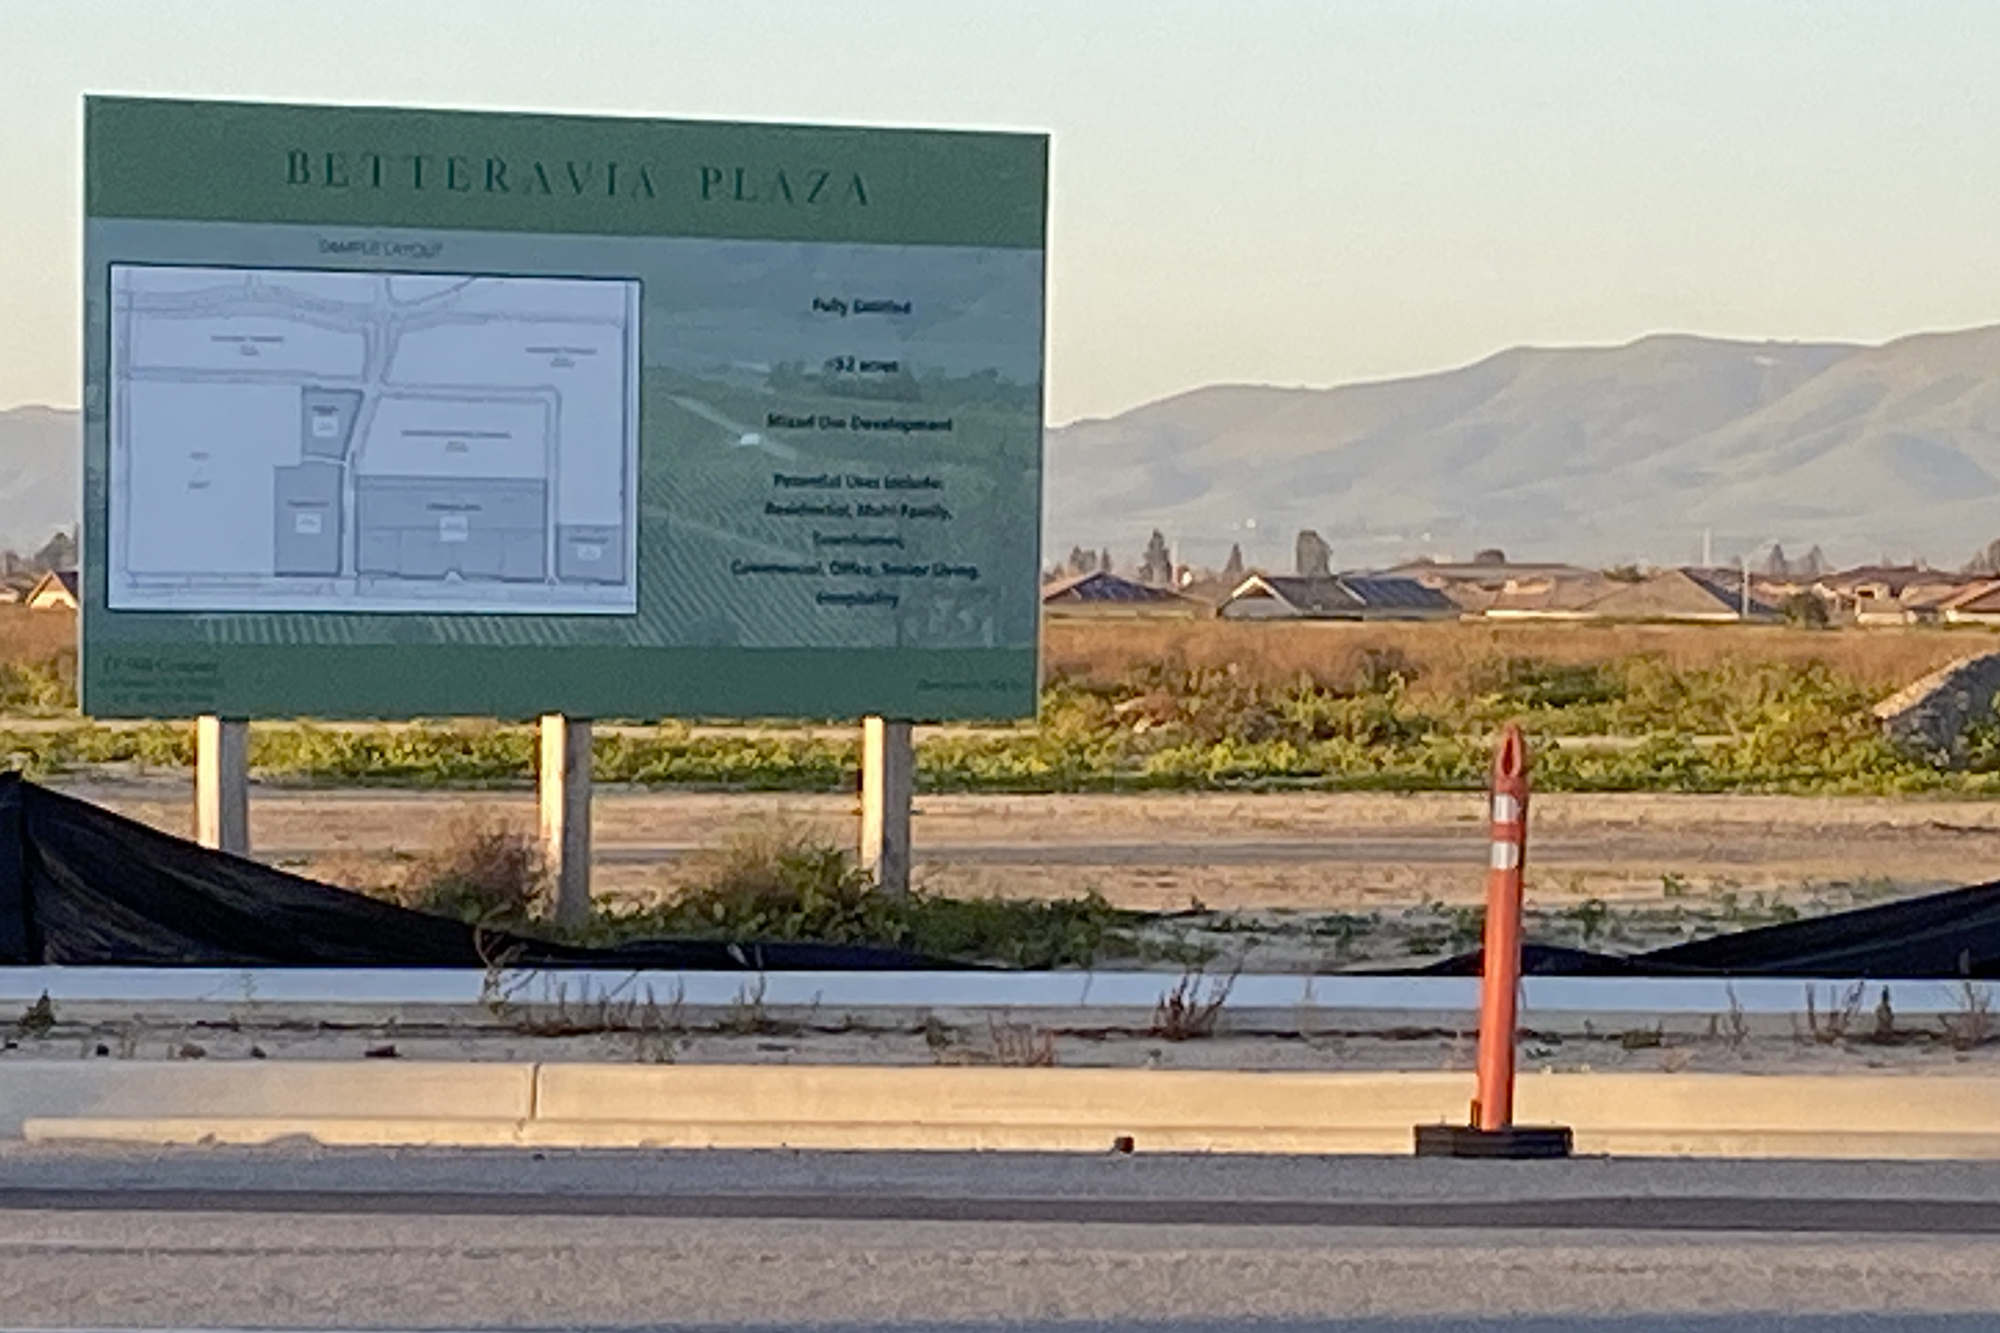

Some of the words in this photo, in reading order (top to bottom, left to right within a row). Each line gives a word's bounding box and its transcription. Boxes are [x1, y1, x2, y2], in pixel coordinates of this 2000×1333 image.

[284, 149, 657, 199] BETTERAVIA
[700, 165, 870, 207] PLAZA
[813, 297, 847, 318] Fully
[851, 414, 953, 434] Development
